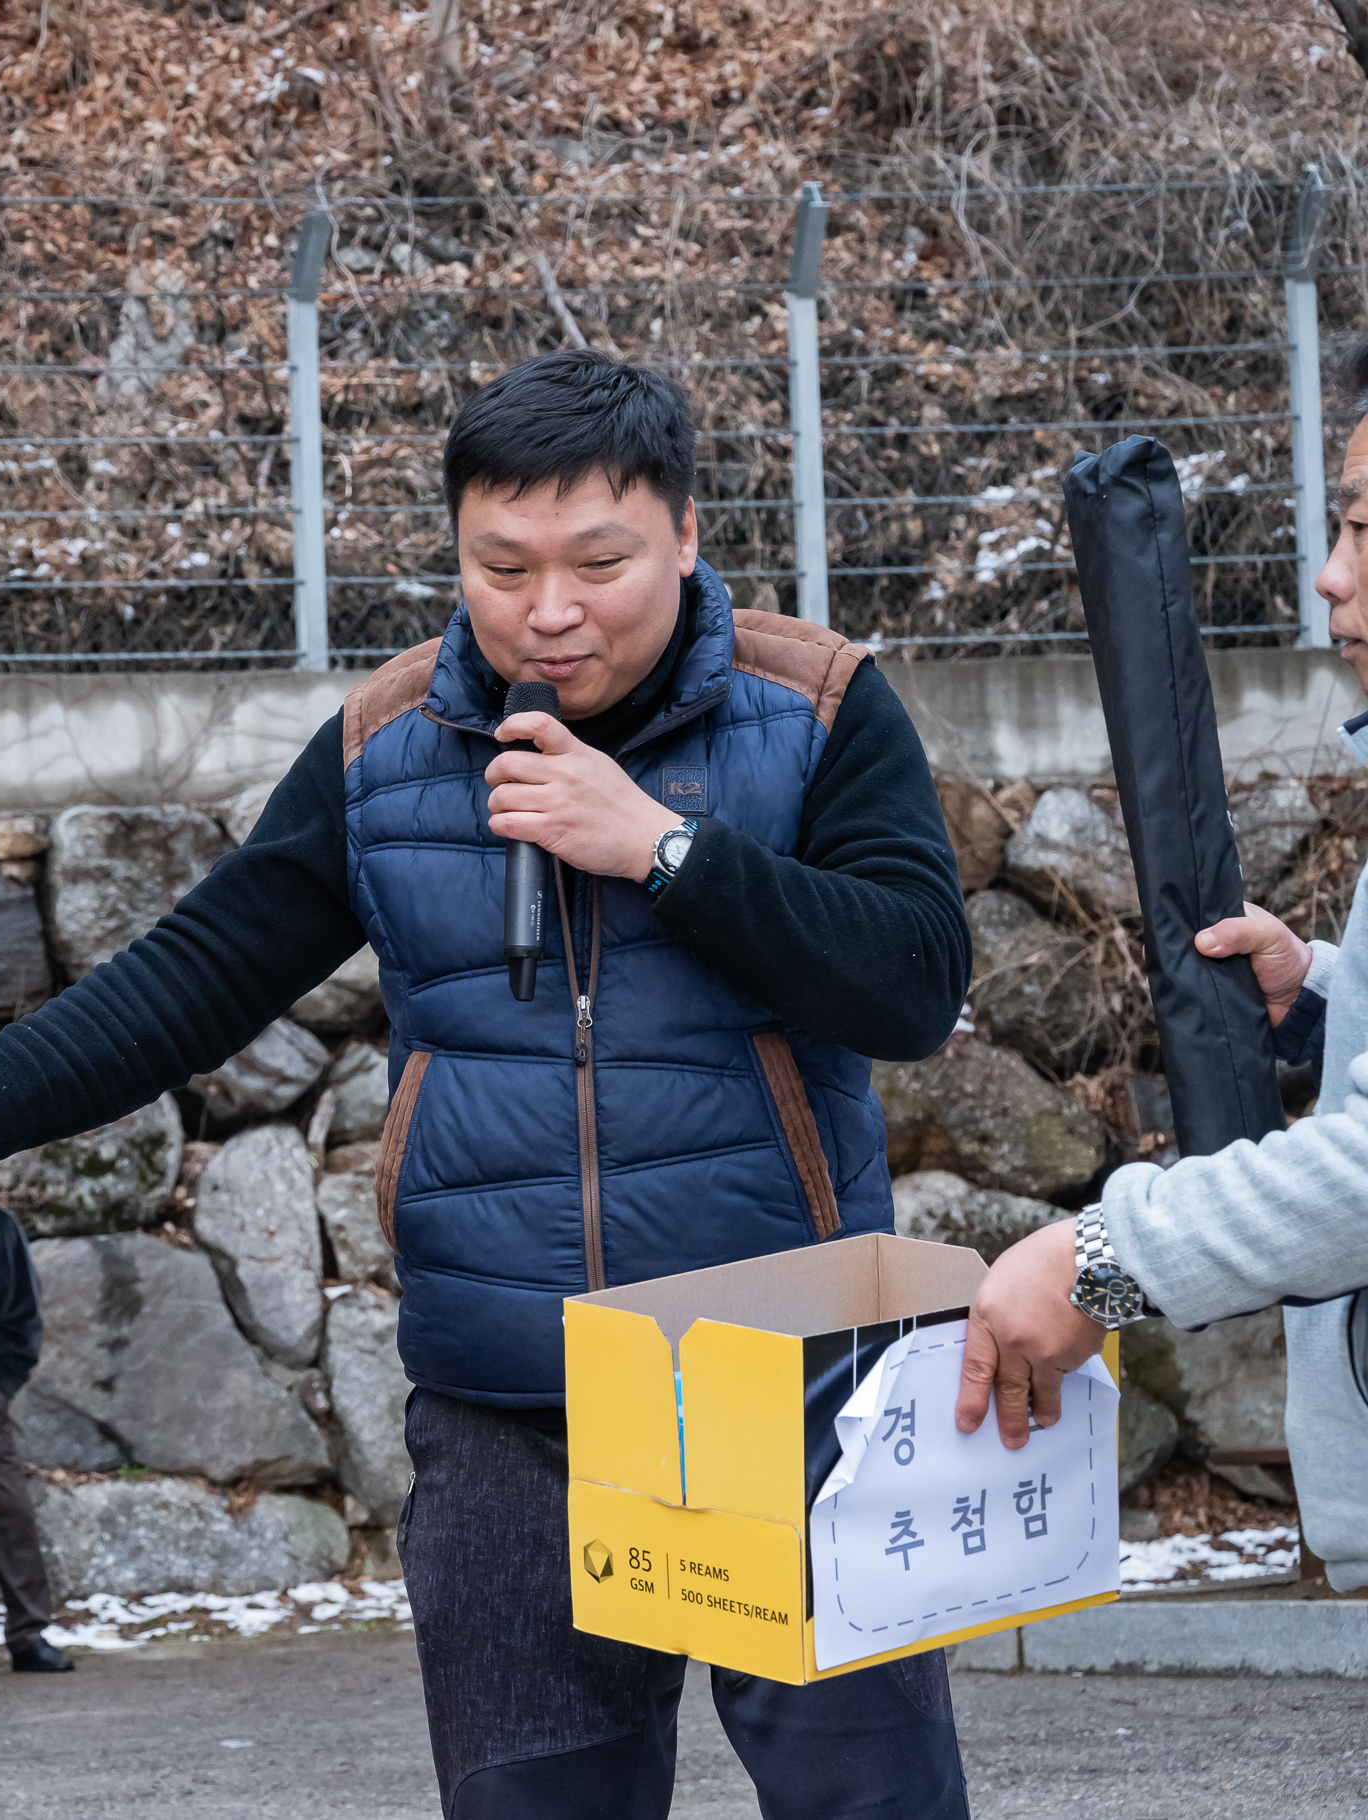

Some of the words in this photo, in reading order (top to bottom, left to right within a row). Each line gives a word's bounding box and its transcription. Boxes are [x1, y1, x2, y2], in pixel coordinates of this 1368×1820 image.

[668, 782, 701, 796] K2
[628, 1547, 652, 1572] 85
[680, 1559, 686, 1571] 5
[688, 1561, 730, 1582] REAMS
[630, 1577, 655, 1594] GSM
[681, 1588, 703, 1605] 500
[707, 1594, 789, 1626] SHEETS/REAM
